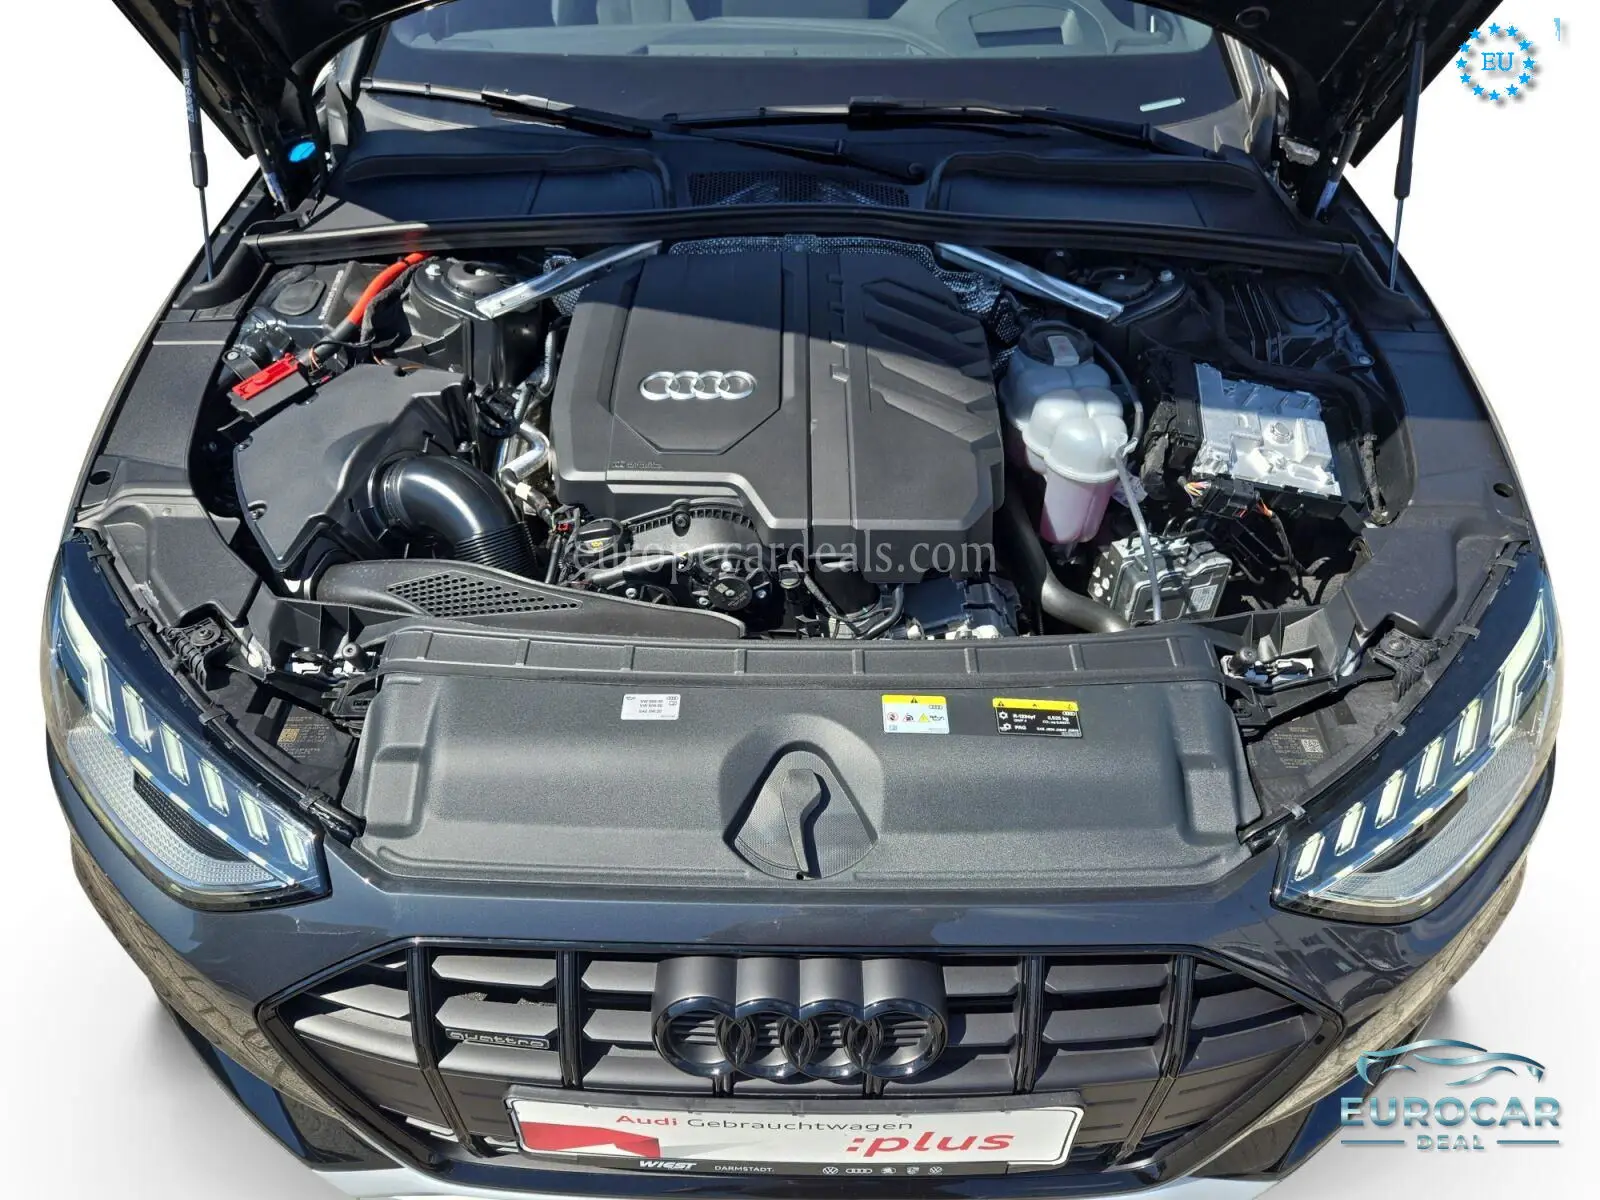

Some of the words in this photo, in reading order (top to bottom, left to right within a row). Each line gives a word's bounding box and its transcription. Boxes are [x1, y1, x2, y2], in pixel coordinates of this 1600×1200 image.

[449, 1031, 545, 1049] quattro
[615, 1114, 677, 1126] Audi
[687, 1118, 913, 1132] Gebrauchtwagen
